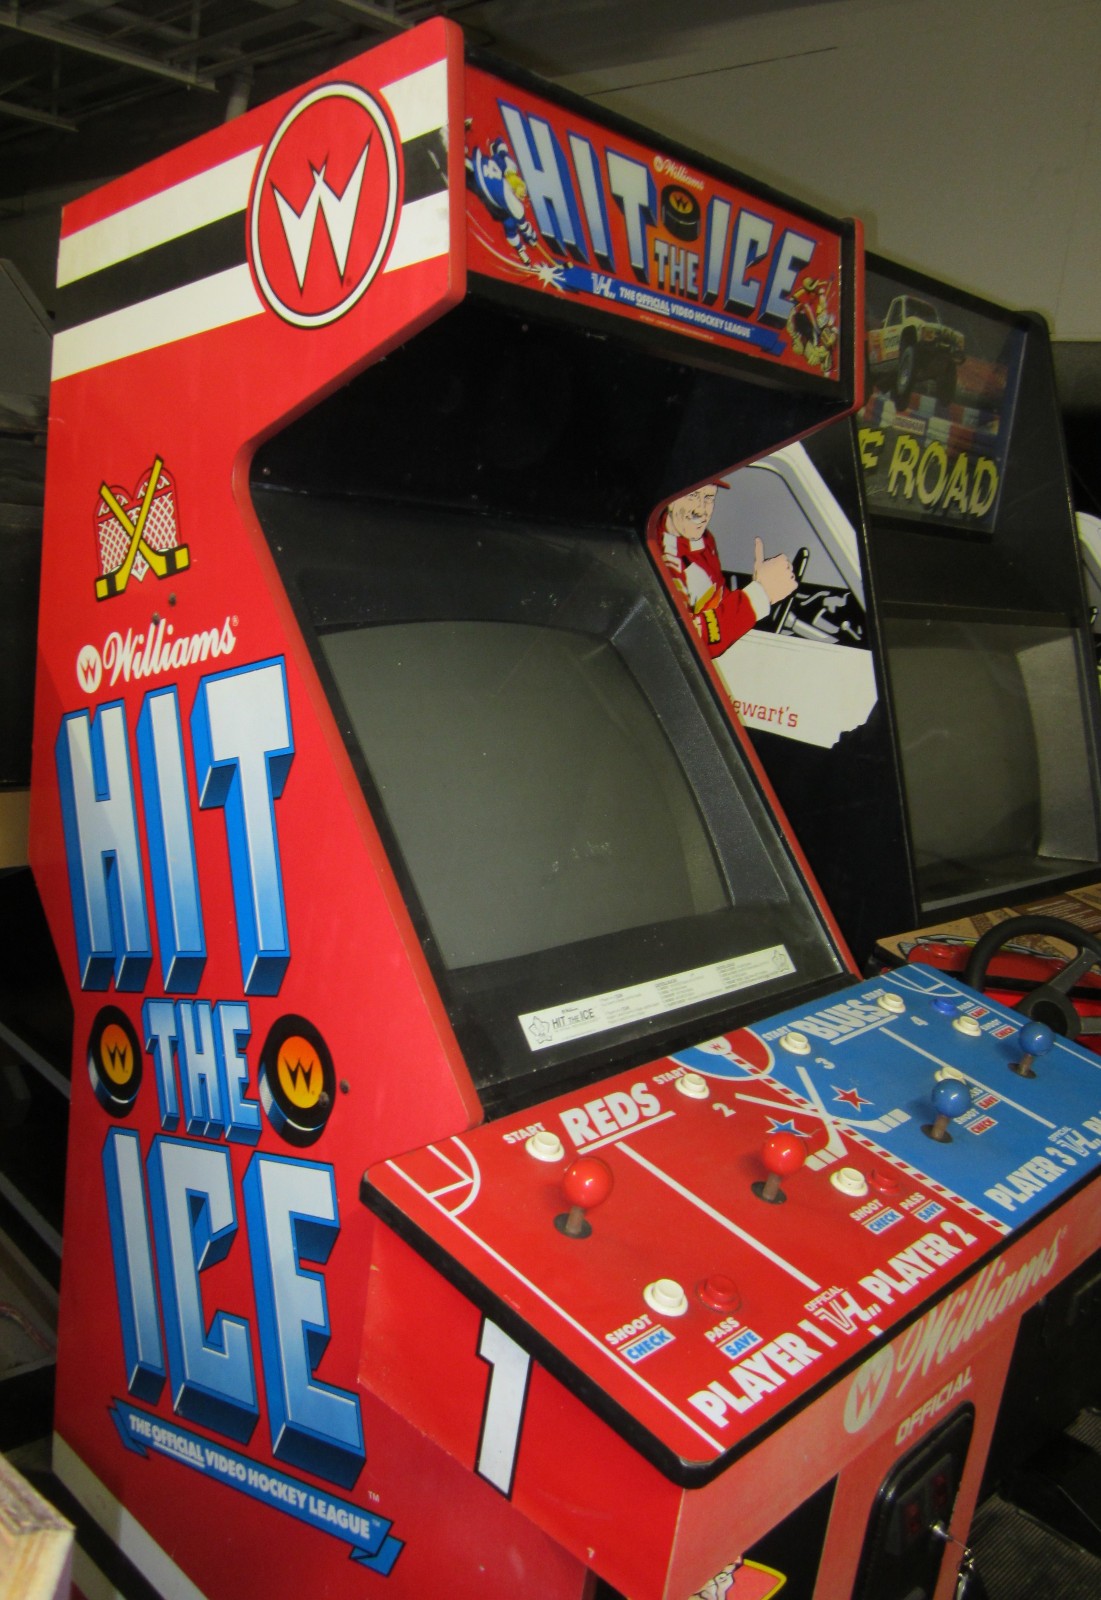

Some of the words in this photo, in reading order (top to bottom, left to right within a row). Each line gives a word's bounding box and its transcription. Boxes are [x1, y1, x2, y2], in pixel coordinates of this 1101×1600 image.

[497, 97, 657, 285] HIT
[663, 158, 705, 191] Williams
[653, 238, 699, 301] THE
[702, 194, 820, 330] ICE
[619, 286, 636, 301] THE
[635, 292, 671, 314] OFFICIAL
[670, 303, 695, 320] VIDEO
[694, 311, 724, 330] HOCKEY
[723, 320, 752, 338] LEAGUE
[887, 434, 999, 518] ROAD
[102, 617, 237, 687] Williams
[730, 698, 798, 728] ewart's
[55, 654, 296, 998] HIT
[551, 1015, 566, 1030] HIT
[579, 1008, 595, 1021] ICE
[762, 1025, 792, 1042] START
[788, 998, 891, 1040] BLUES
[910, 1015, 929, 1027] 4
[141, 997, 263, 1146] THE
[652, 1067, 688, 1086] START
[814, 1057, 836, 1070] 3
[558, 1082, 662, 1147] REDS
[711, 1102, 737, 1119] 2
[952, 1108, 980, 1126] SHOOT
[968, 1115, 995, 1135] CHECK
[502, 1121, 547, 1145] START
[983, 1155, 1068, 1212] PLAYER
[1044, 1146, 1077, 1167] 3
[848, 1198, 884, 1223] SHOOT
[899, 1191, 926, 1211] PASS
[915, 1201, 943, 1224] SAVE
[867, 1210, 901, 1235] CHECK
[857, 1232, 956, 1305] PLAYER
[943, 1221, 979, 1251] 2
[103, 1125, 368, 1491] ICE
[803, 1285, 844, 1312] OFFICIAL
[896, 1227, 1062, 1399] Williams
[604, 1314, 654, 1346] SHOOT
[625, 1329, 671, 1362] CHECK
[704, 1316, 741, 1344] PASS
[725, 1330, 758, 1359] SAVE
[687, 1331, 823, 1429] PLAYER
[797, 1319, 838, 1348] 1
[894, 1366, 973, 1447] OFFICIAL
[128, 1413, 152, 1438] THE
[152, 1424, 205, 1463] OFFICIAL
[204, 1448, 247, 1482] VIDEO
[247, 1468, 308, 1511] HOCKEY
[308, 1495, 371, 1540] LEAGUE
